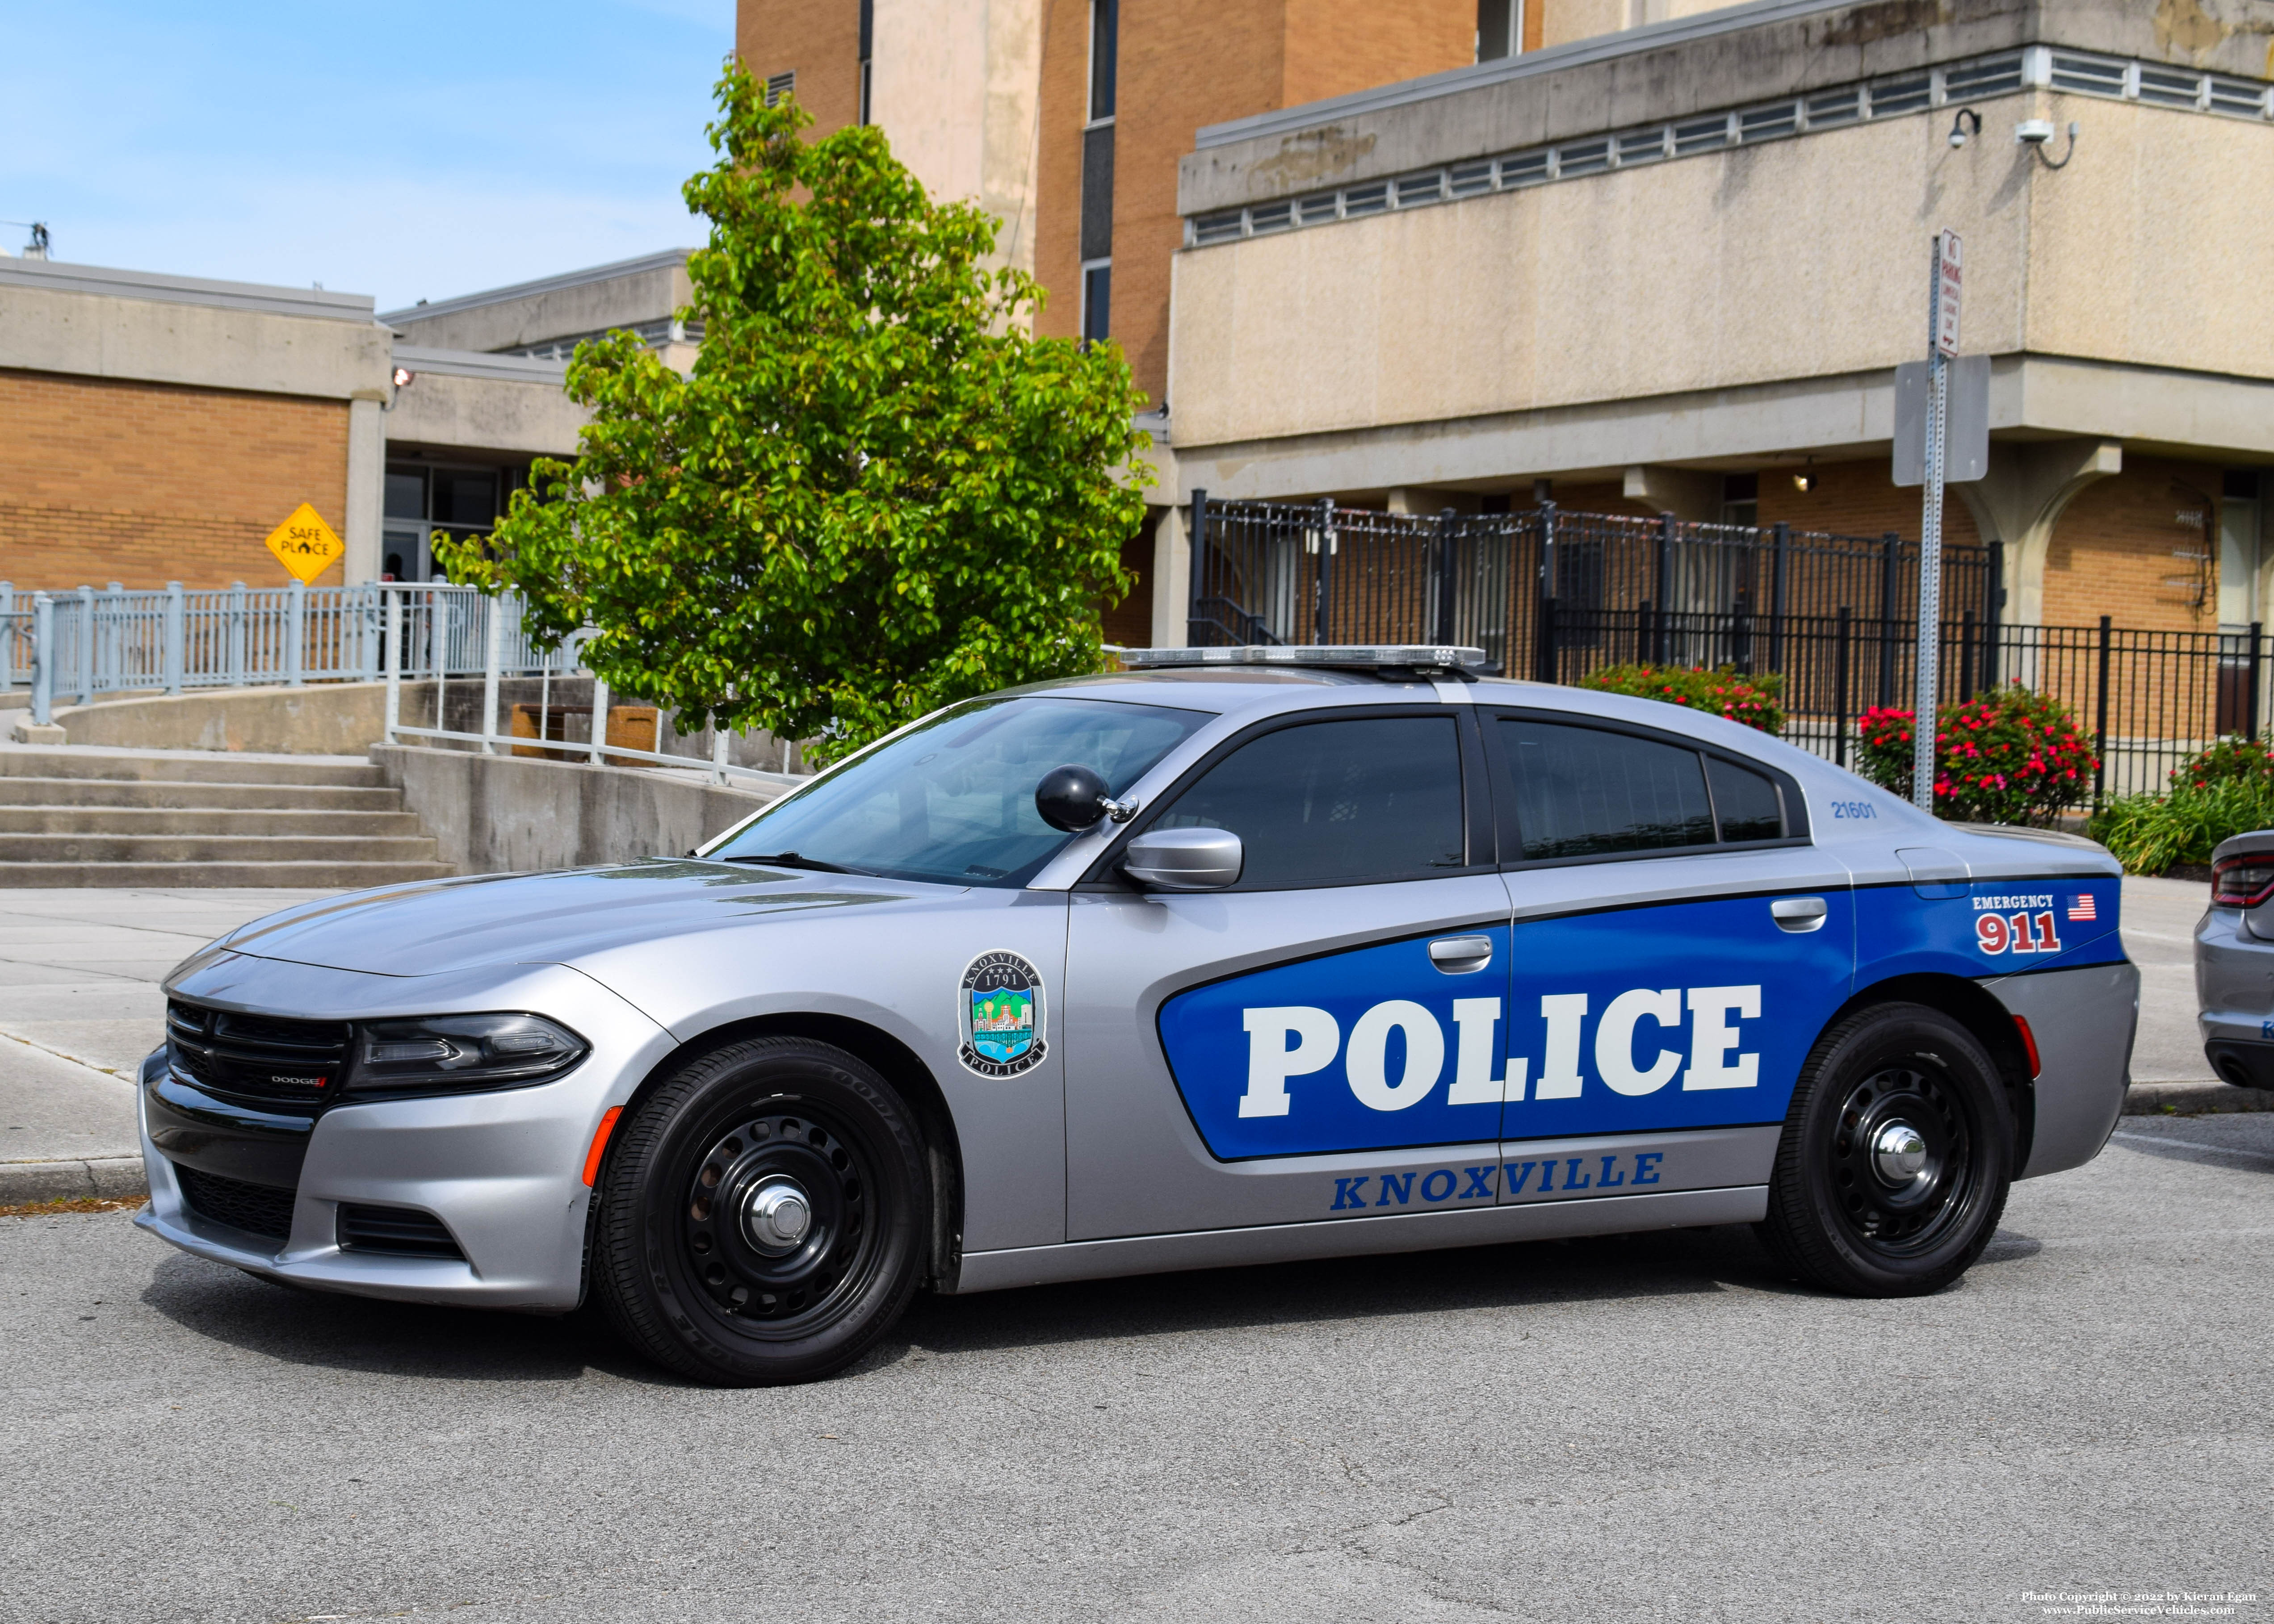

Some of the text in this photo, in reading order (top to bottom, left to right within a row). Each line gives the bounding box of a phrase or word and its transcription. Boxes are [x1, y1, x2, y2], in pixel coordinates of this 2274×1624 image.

[289, 527, 320, 541] SAFE
[1831, 802, 1877, 818] 21601
[1972, 895, 2053, 910] EMERGENCY
[1976, 911, 2061, 955] 911
[965, 954, 1037, 984] KNOXVILLE
[986, 974, 1017, 986] 1791
[1238, 984, 1761, 1118] POLICE
[969, 1054, 1037, 1075] POLICE
[272, 1076, 320, 1084] DODGE
[1330, 1153, 1663, 1210] KNOXVILLE
